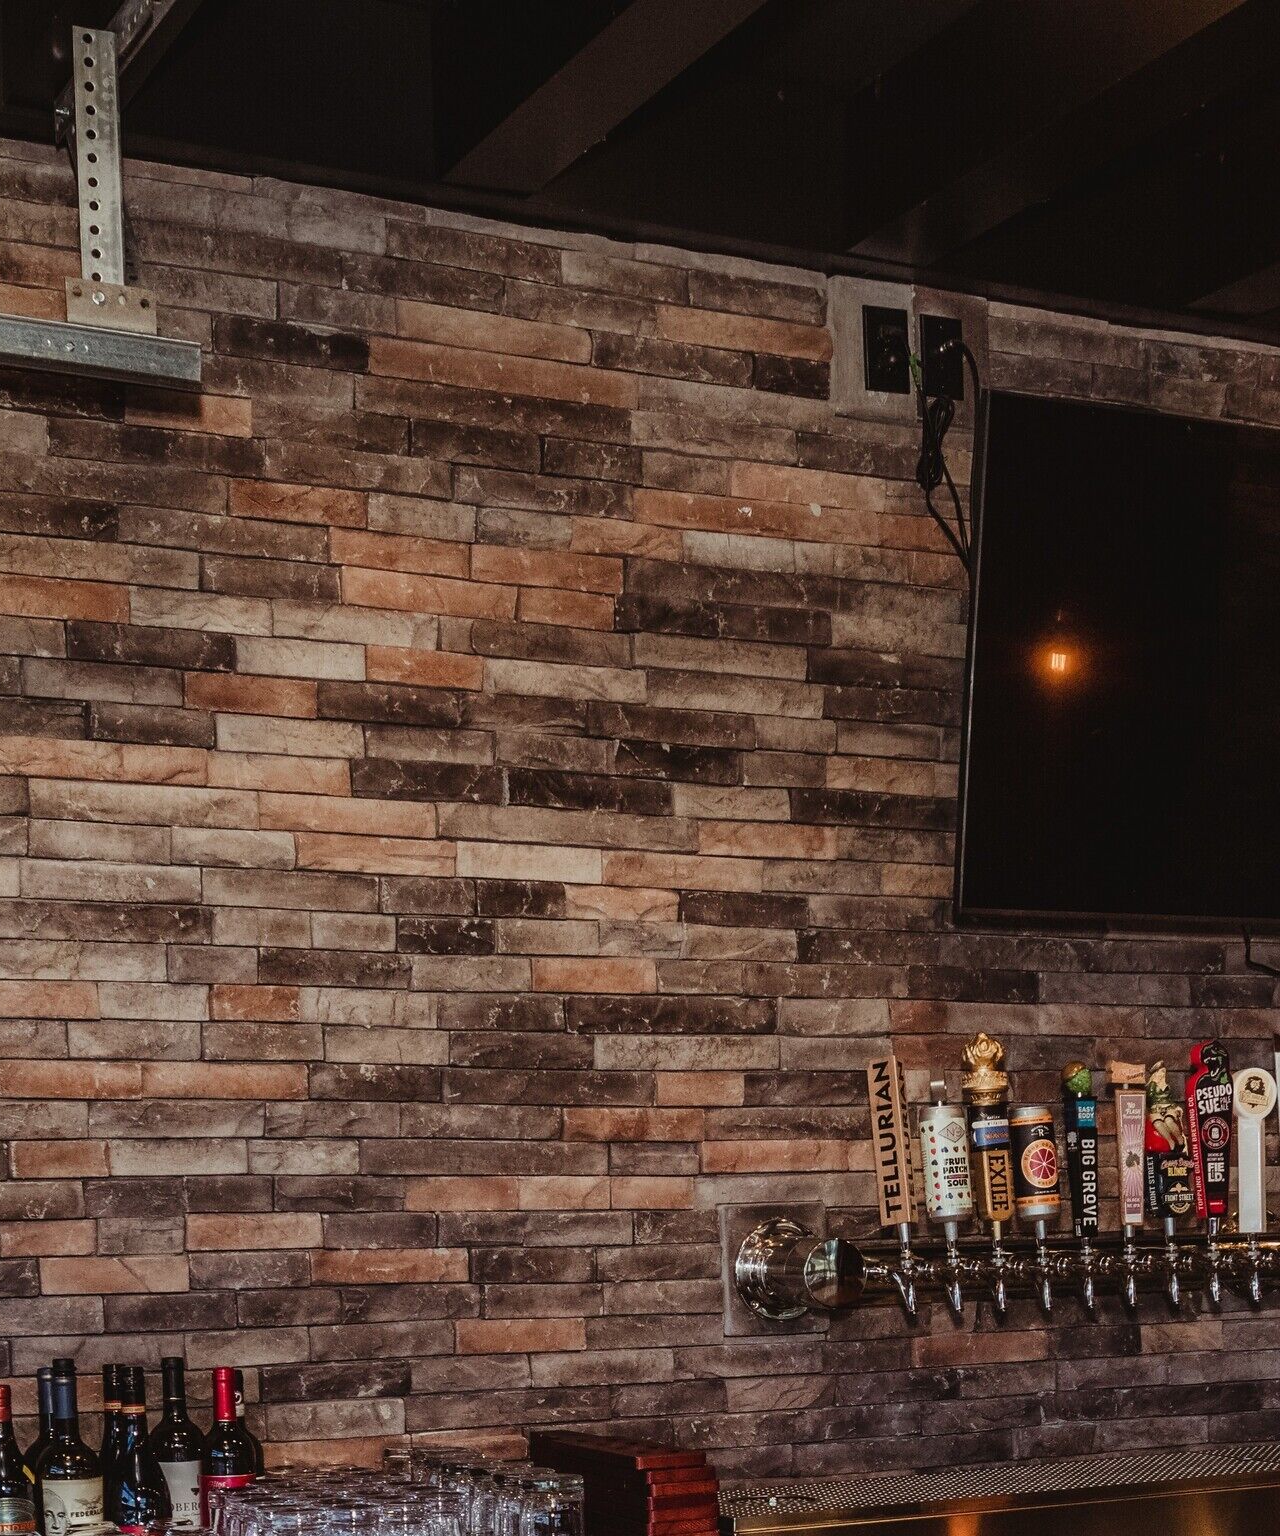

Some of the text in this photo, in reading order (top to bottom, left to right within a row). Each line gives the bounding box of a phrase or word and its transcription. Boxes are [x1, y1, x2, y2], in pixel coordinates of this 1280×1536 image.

[1196, 1083, 1232, 1101] PSEUDO
[1197, 1097, 1221, 1115] SUE
[1190, 1108, 1198, 1143] BREWING
[872, 1060, 902, 1219] TELLURIAN
[942, 1165, 968, 1174] PATCH
[944, 1156, 966, 1166] FRUIT
[1192, 1144, 1202, 1175] GOLIATH
[947, 1178, 968, 1187] SOUR
[1081, 1138, 1098, 1226] BIG GROVE
[1147, 1155, 1159, 1211] FRONT STREET
[1195, 1176, 1205, 1211] TOPPLING
[1178, 1193, 1194, 1201] STREET
